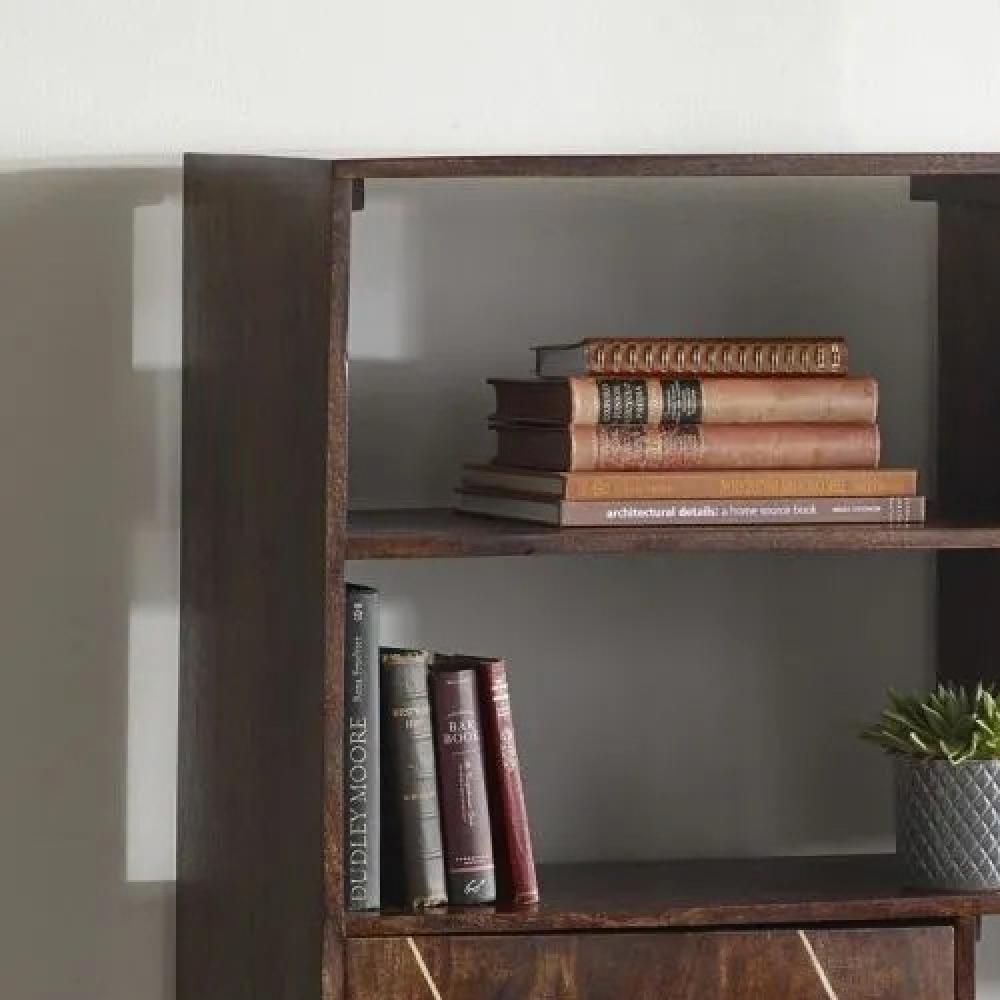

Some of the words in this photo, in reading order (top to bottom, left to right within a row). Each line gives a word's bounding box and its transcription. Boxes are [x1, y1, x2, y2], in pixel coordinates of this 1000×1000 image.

[607, 505, 675, 518] architectural
[350, 716, 367, 804] MOORE
[350, 808, 367, 902] DUDLEY
